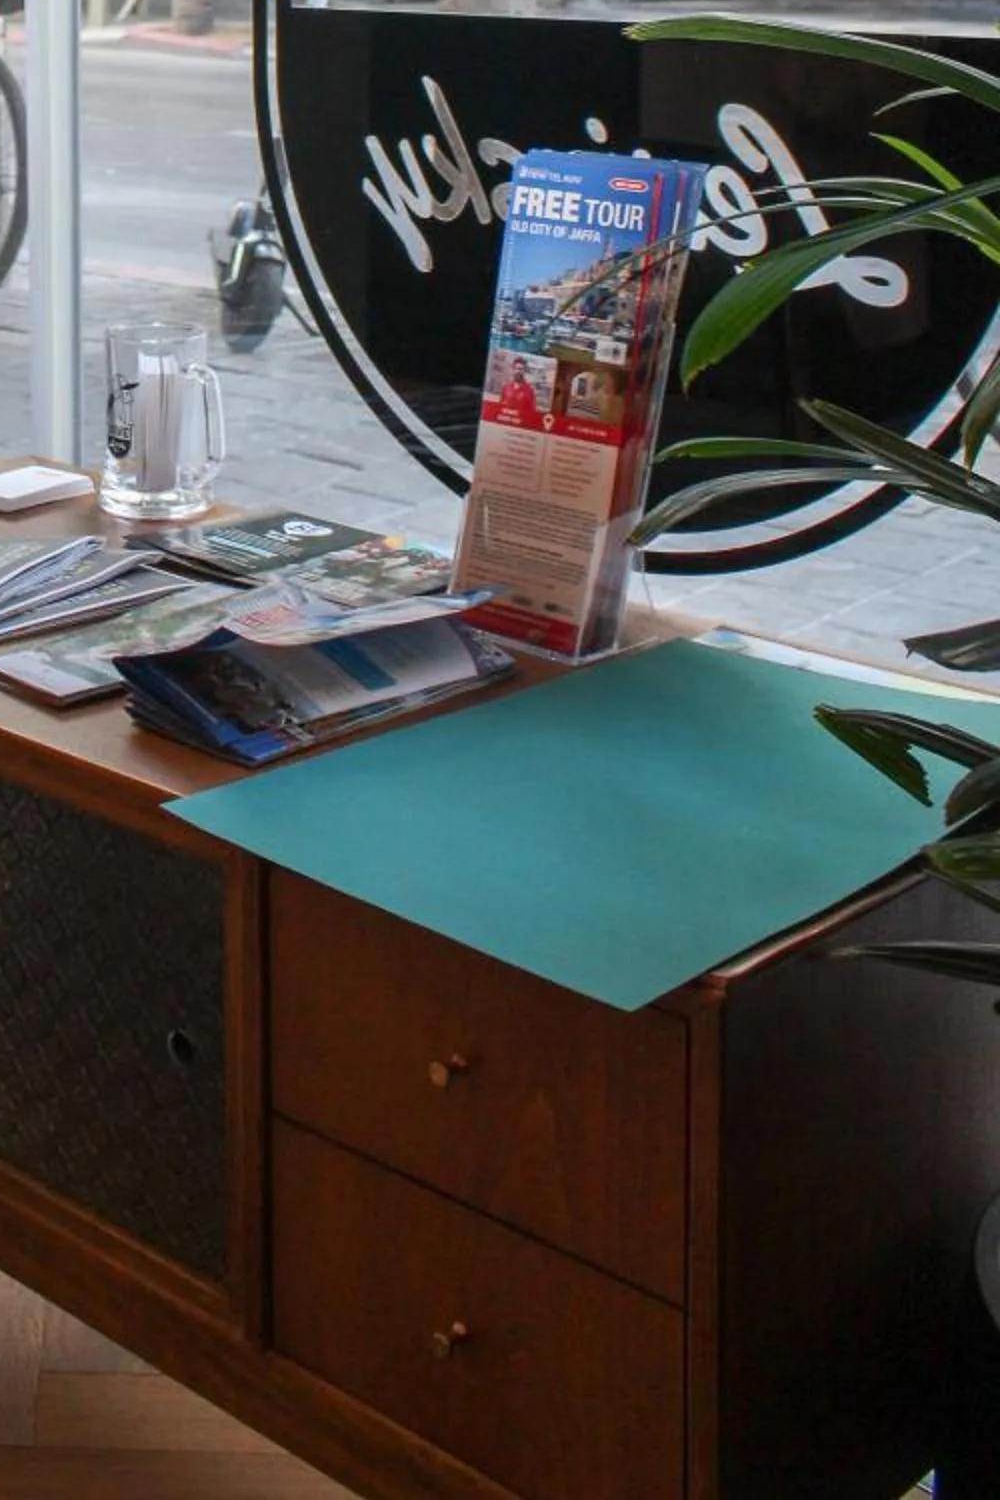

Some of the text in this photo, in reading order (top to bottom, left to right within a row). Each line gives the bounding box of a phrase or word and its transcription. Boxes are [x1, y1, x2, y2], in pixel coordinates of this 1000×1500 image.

[511, 185, 645, 231] FREE TOUR
[510, 219, 601, 244] OLD CITY OF JAFFA
